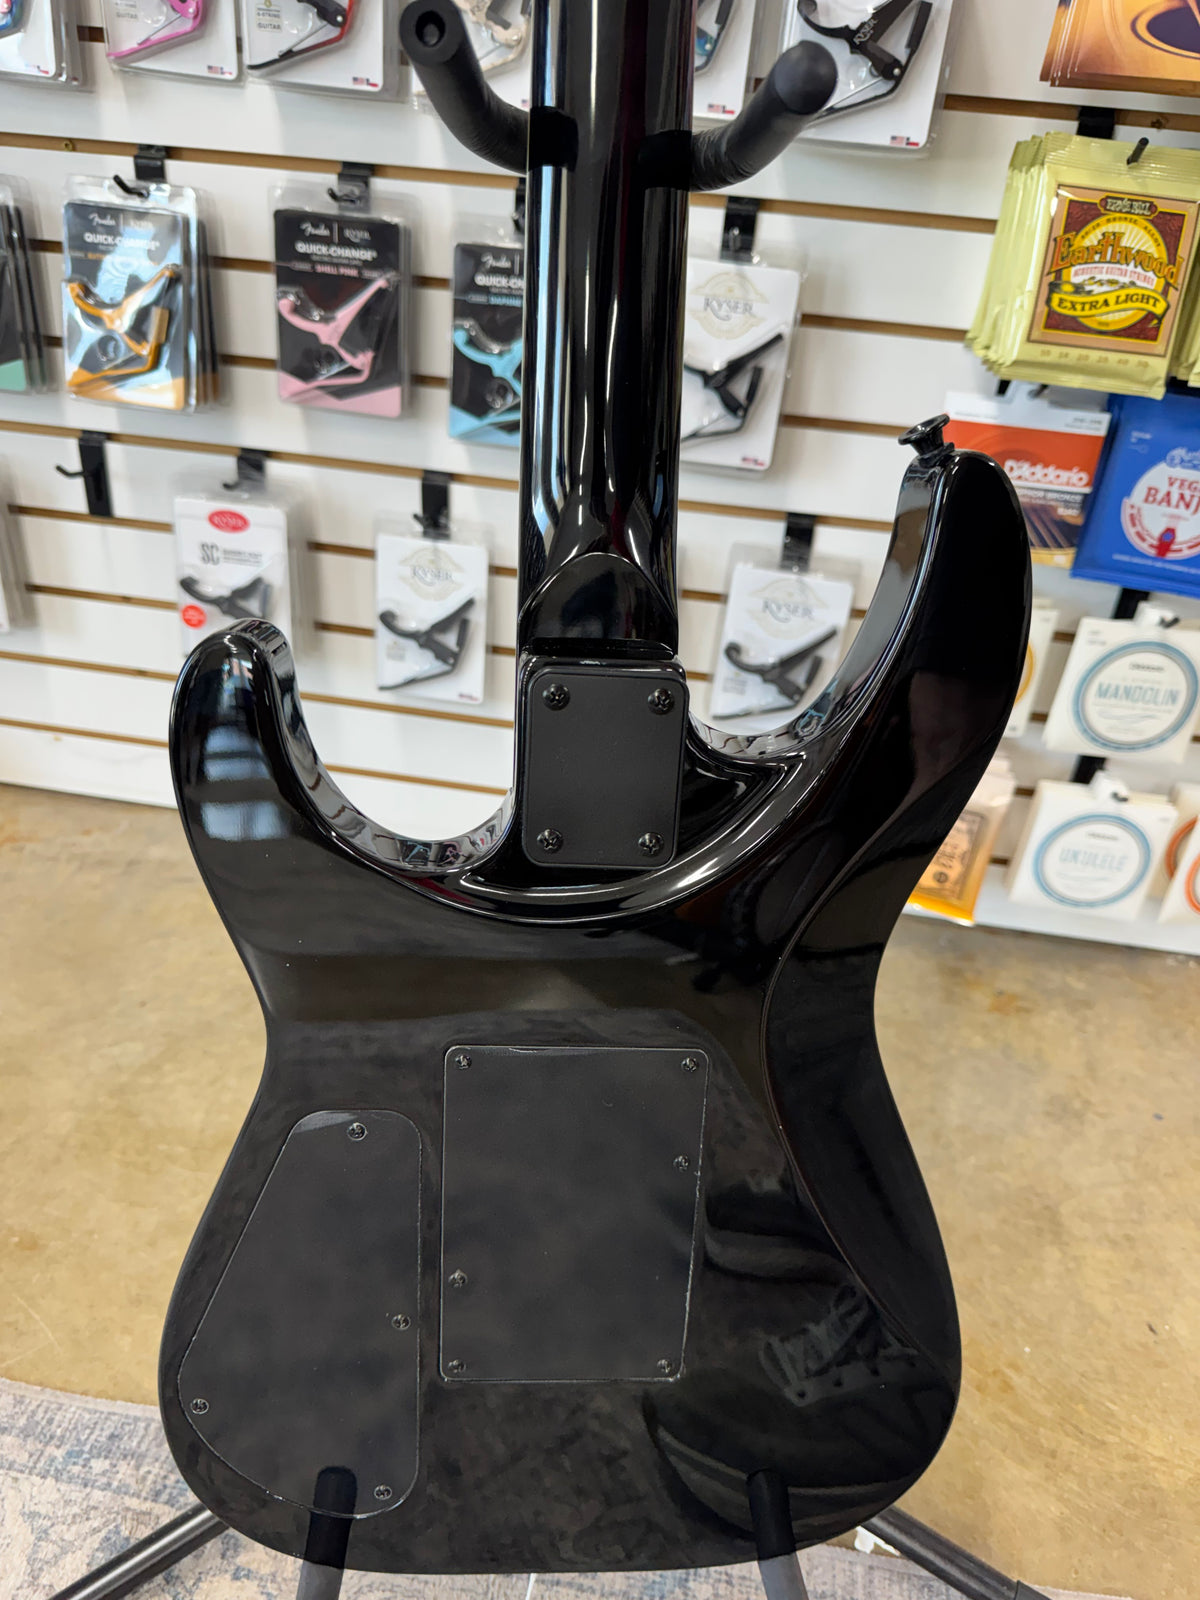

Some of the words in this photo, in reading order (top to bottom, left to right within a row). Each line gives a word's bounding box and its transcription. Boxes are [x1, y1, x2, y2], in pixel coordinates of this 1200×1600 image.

[257, 22, 282, 30] GUITAR
[88, 212, 117, 227] Fender
[300, 221, 331, 237] Fender
[1046, 231, 1185, 287] Earthwood
[703, 295, 758, 322] KYSER
[1057, 297, 1110, 313] EXTRA
[1115, 292, 1161, 308] LIGHT
[1168, 476, 1200, 493] VEG
[1143, 486, 1200, 516] BANJ
[200, 541, 220, 566] SC
[413, 564, 456, 587] KYSER
[1095, 681, 1181, 706] MANDOLIN
[1058, 847, 1129, 872] UKULELE
